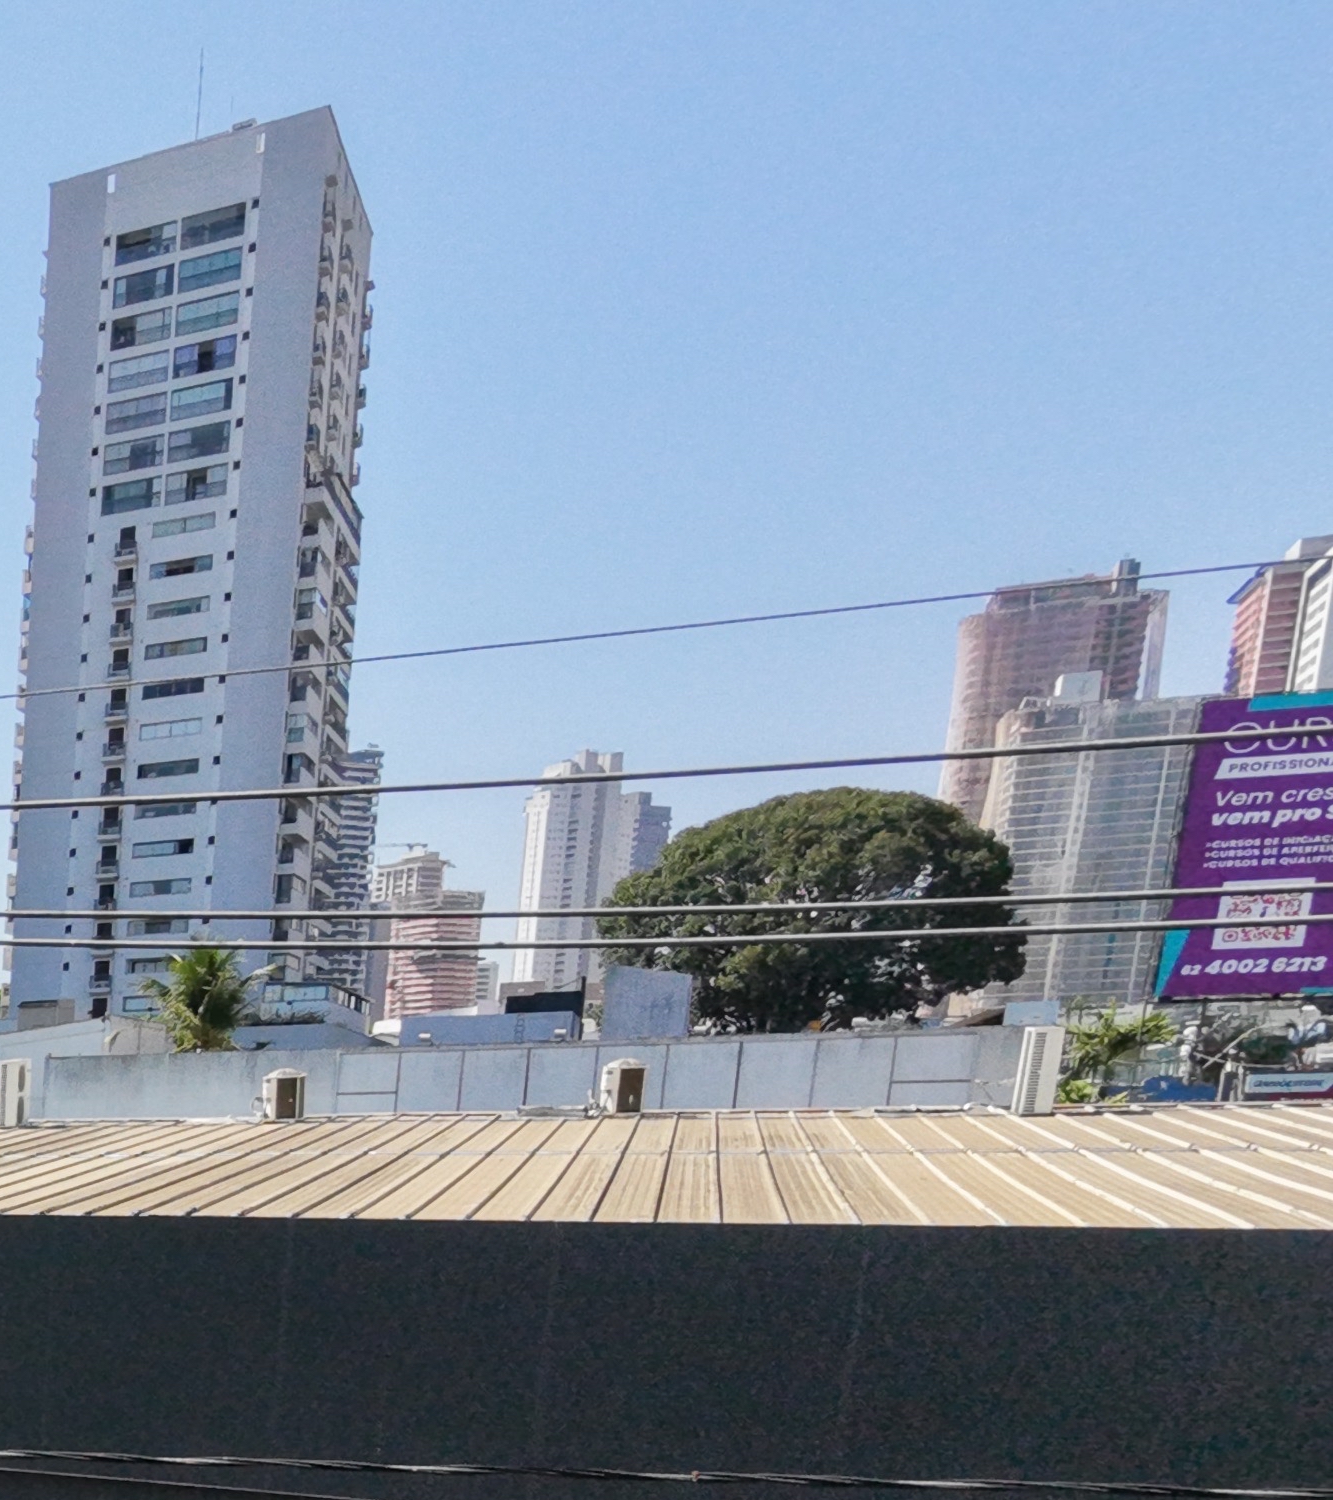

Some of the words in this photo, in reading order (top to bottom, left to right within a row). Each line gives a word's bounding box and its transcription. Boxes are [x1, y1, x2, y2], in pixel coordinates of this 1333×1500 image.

[1223, 716, 1333, 754] CUR
[1228, 757, 1333, 774] PROFISSION
[1216, 791, 1273, 806] Vem
[1211, 811, 1271, 826] vem
[1271, 807, 1322, 828] pro
[1204, 958, 1268, 975] 4002
[1271, 956, 1328, 973] 6213
